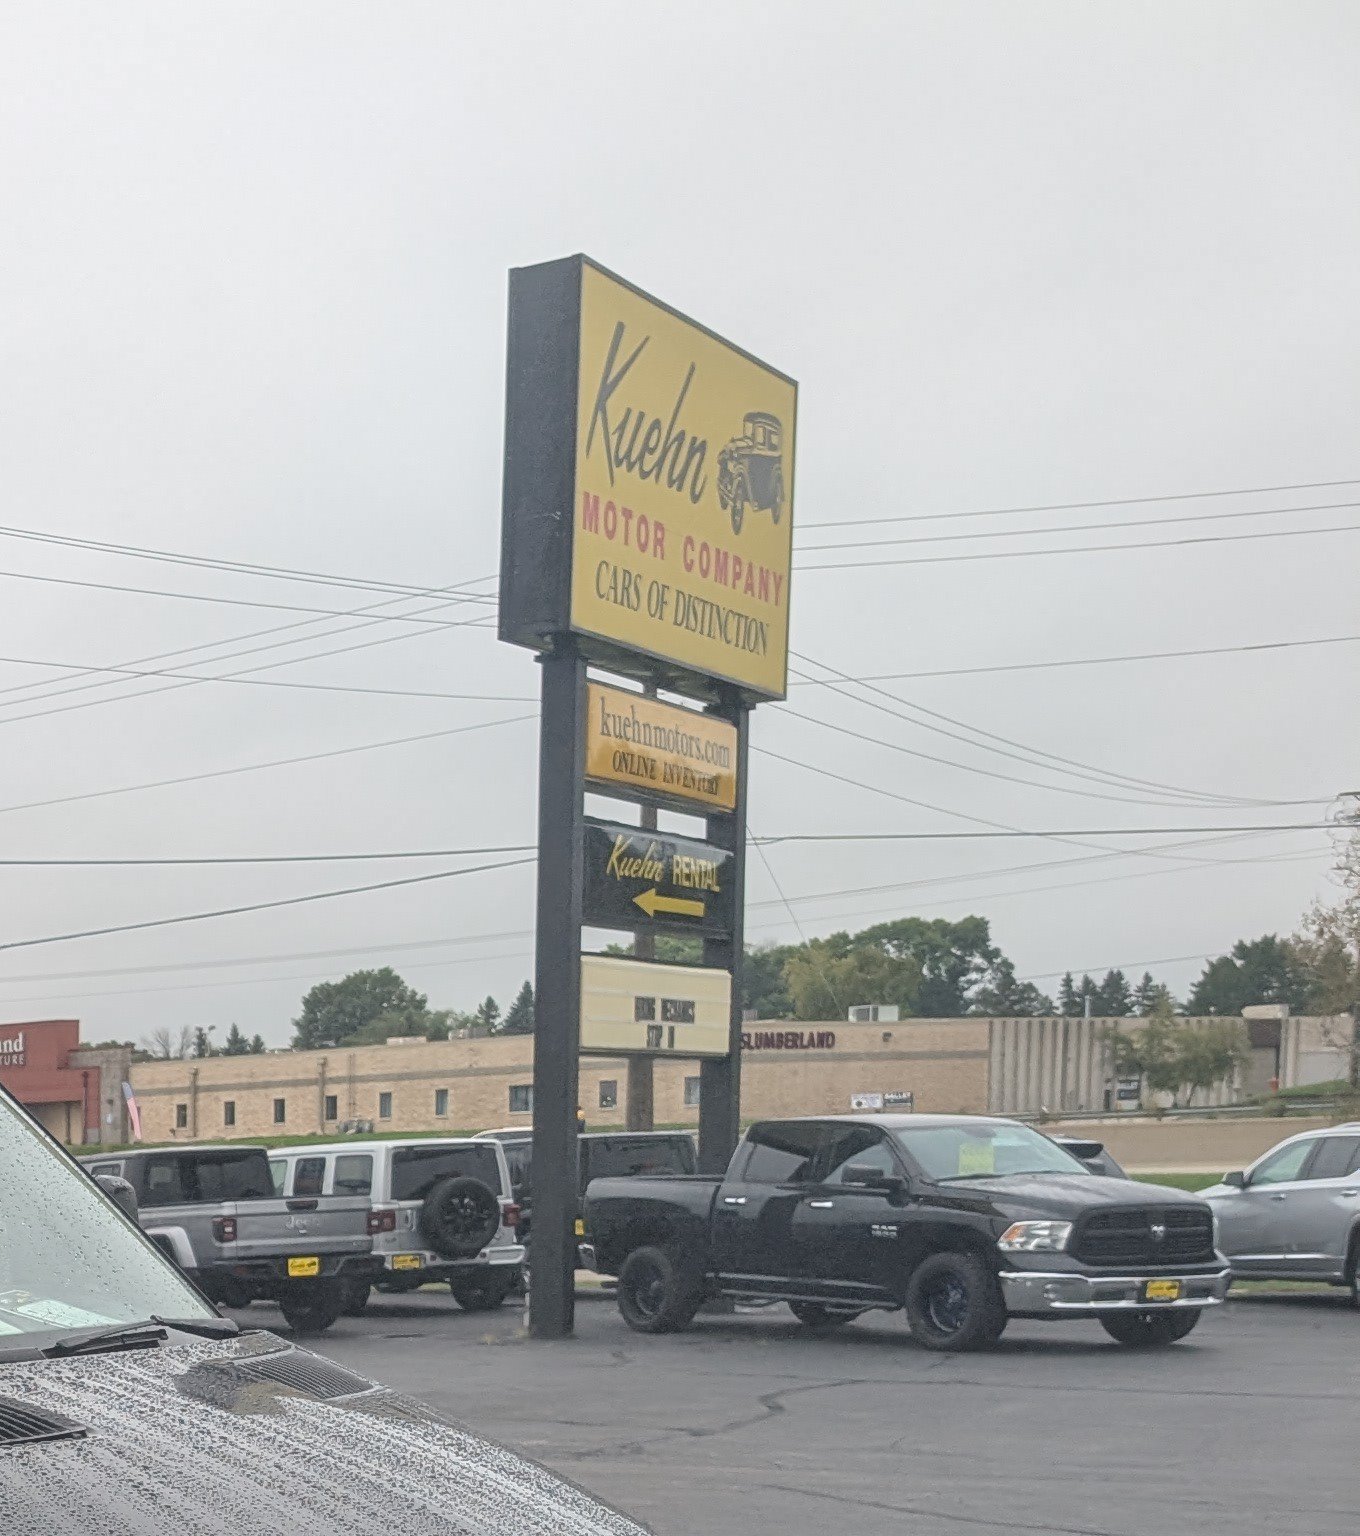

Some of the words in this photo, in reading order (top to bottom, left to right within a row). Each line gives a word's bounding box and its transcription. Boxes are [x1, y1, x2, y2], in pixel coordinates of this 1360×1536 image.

[585, 320, 707, 504] Kuehn
[582, 490, 666, 560] MOTOR
[682, 535, 784, 607] COMPANY
[595, 560, 642, 612] CARS
[647, 580, 670, 621] OF
[672, 589, 768, 656] DISTINCTION
[600, 696, 730, 769] kuehnmotors.com
[612, 749, 657, 780] ONLINE
[606, 834, 663, 881] Kuehn
[672, 854, 720, 892] RENTAL
[739, 1031, 835, 1050] SLUMBERLAND
